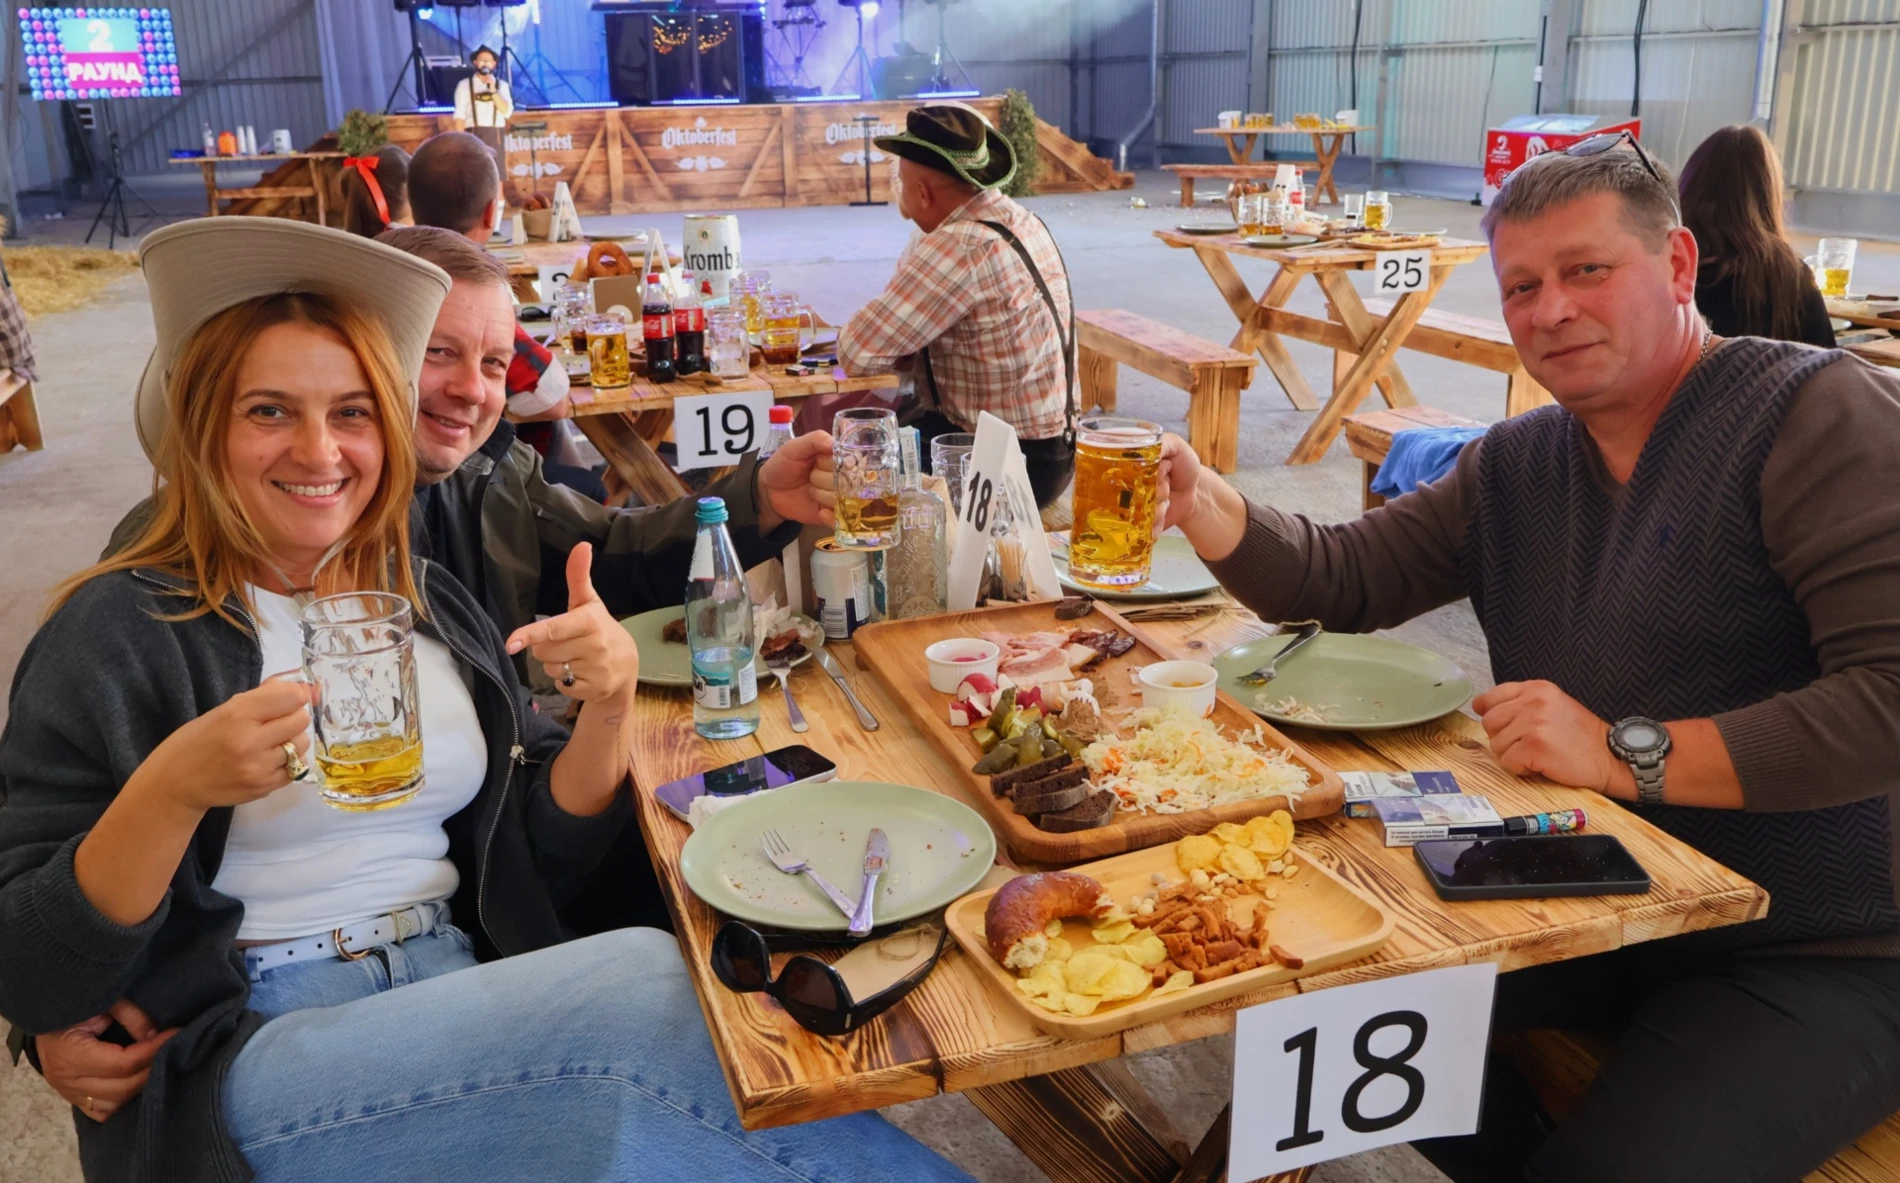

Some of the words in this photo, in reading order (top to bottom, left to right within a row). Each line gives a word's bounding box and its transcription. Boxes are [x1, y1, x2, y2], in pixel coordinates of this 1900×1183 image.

[86, 19, 114, 53] 2
[67, 62, 144, 84] РАУНД
[503, 131, 573, 152] ktoberfest
[661, 126, 737, 150] Oktoberfest
[1381, 256, 1423, 289] 25
[696, 403, 755, 456] 19
[966, 471, 993, 532] 18
[1275, 1009, 1428, 1152] 18
